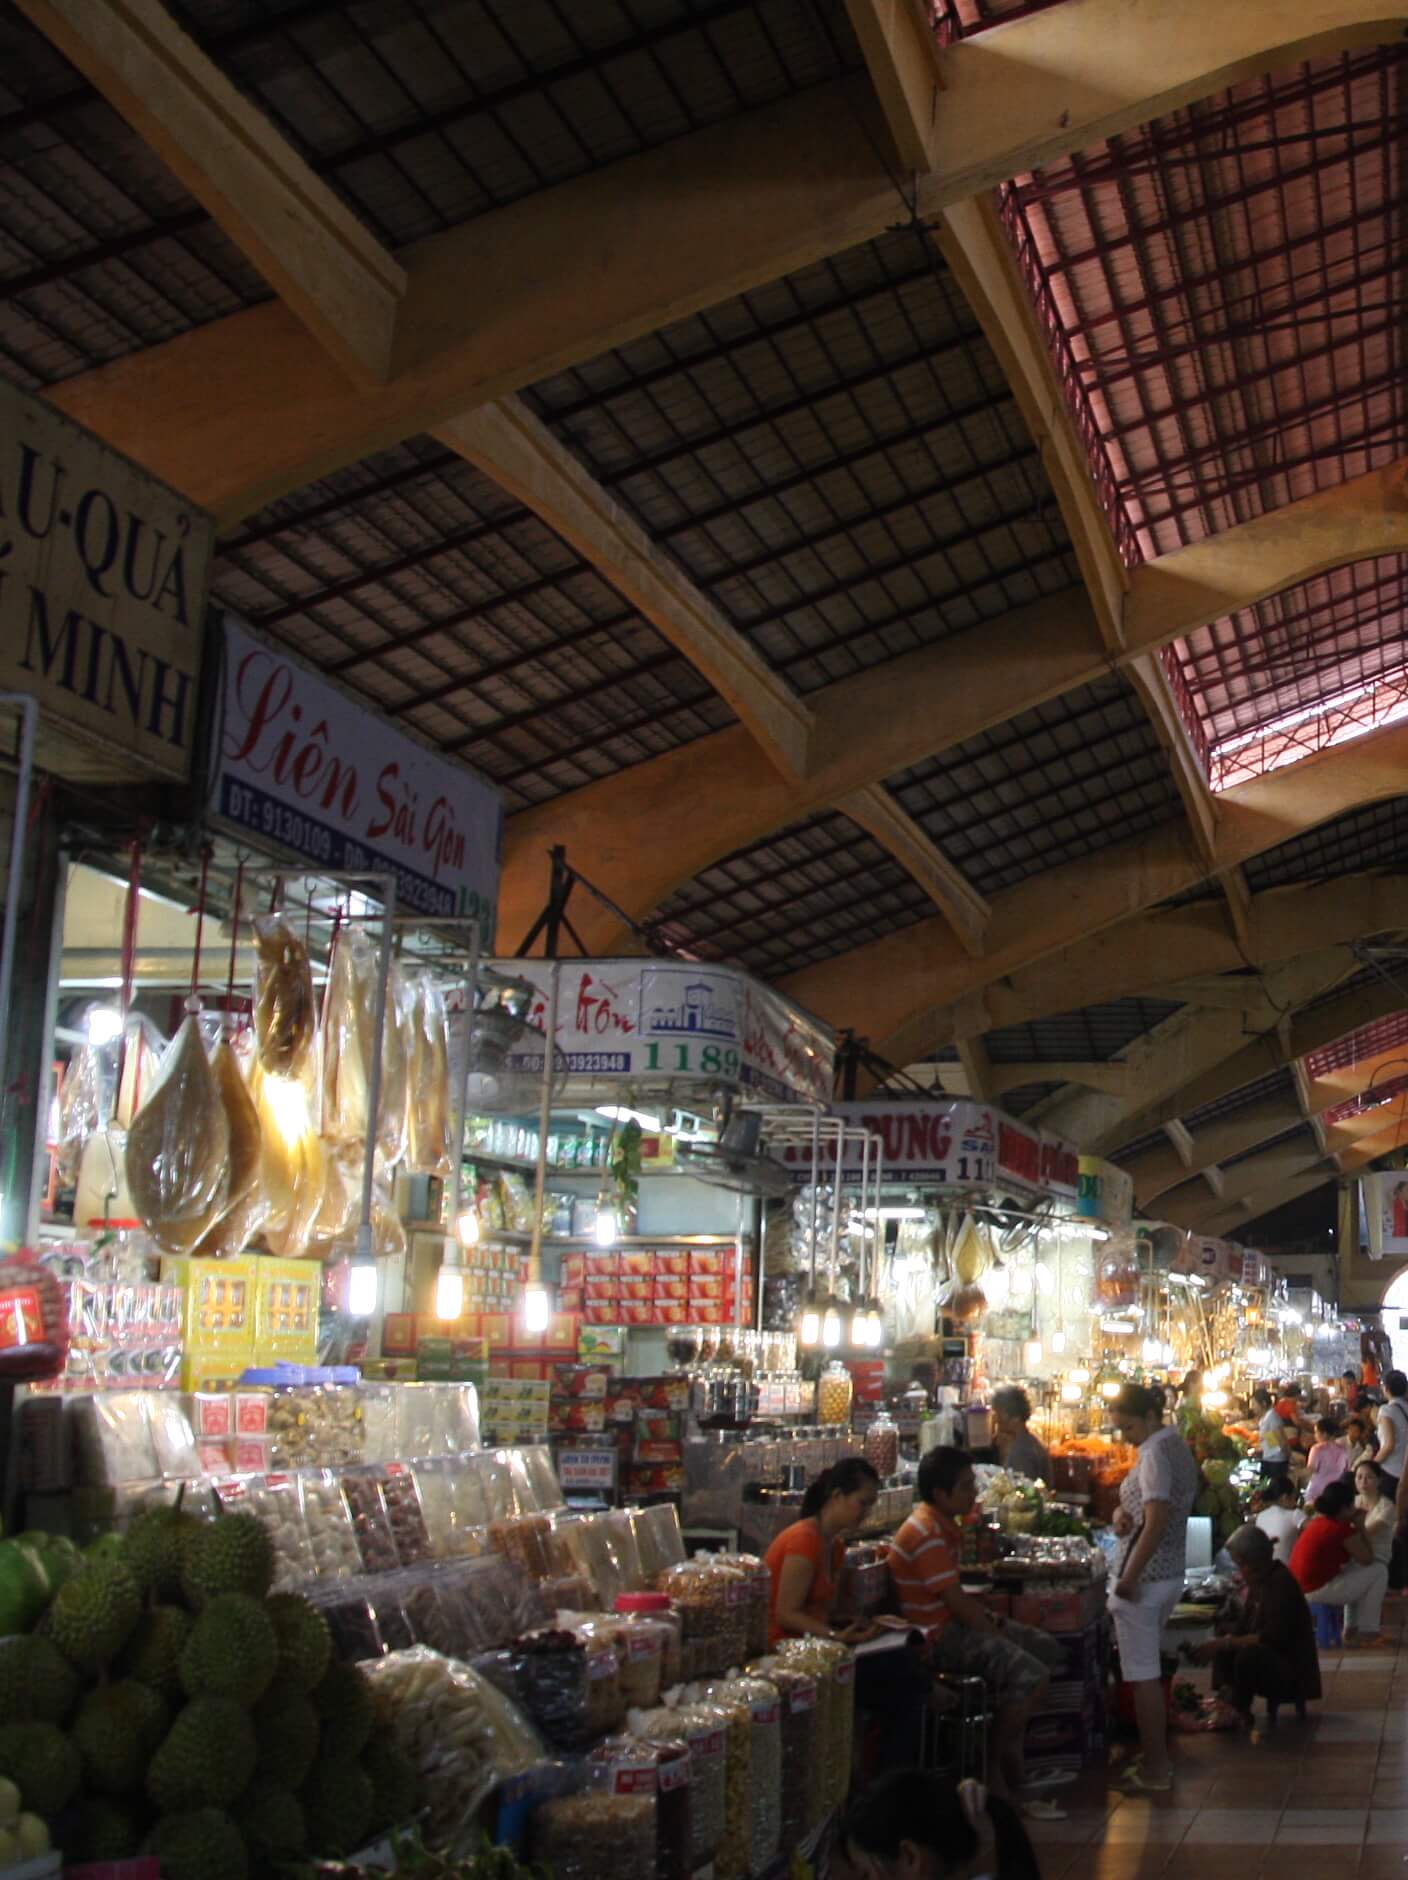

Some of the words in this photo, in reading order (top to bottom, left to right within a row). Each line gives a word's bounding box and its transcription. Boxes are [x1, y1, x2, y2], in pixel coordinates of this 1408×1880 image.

[17, 584, 194, 746] MINH
[224, 650, 360, 820] Liên
[367, 762, 417, 846] Sài
[424, 796, 464, 880] Gòn
[643, 1042, 740, 1076] 1189
